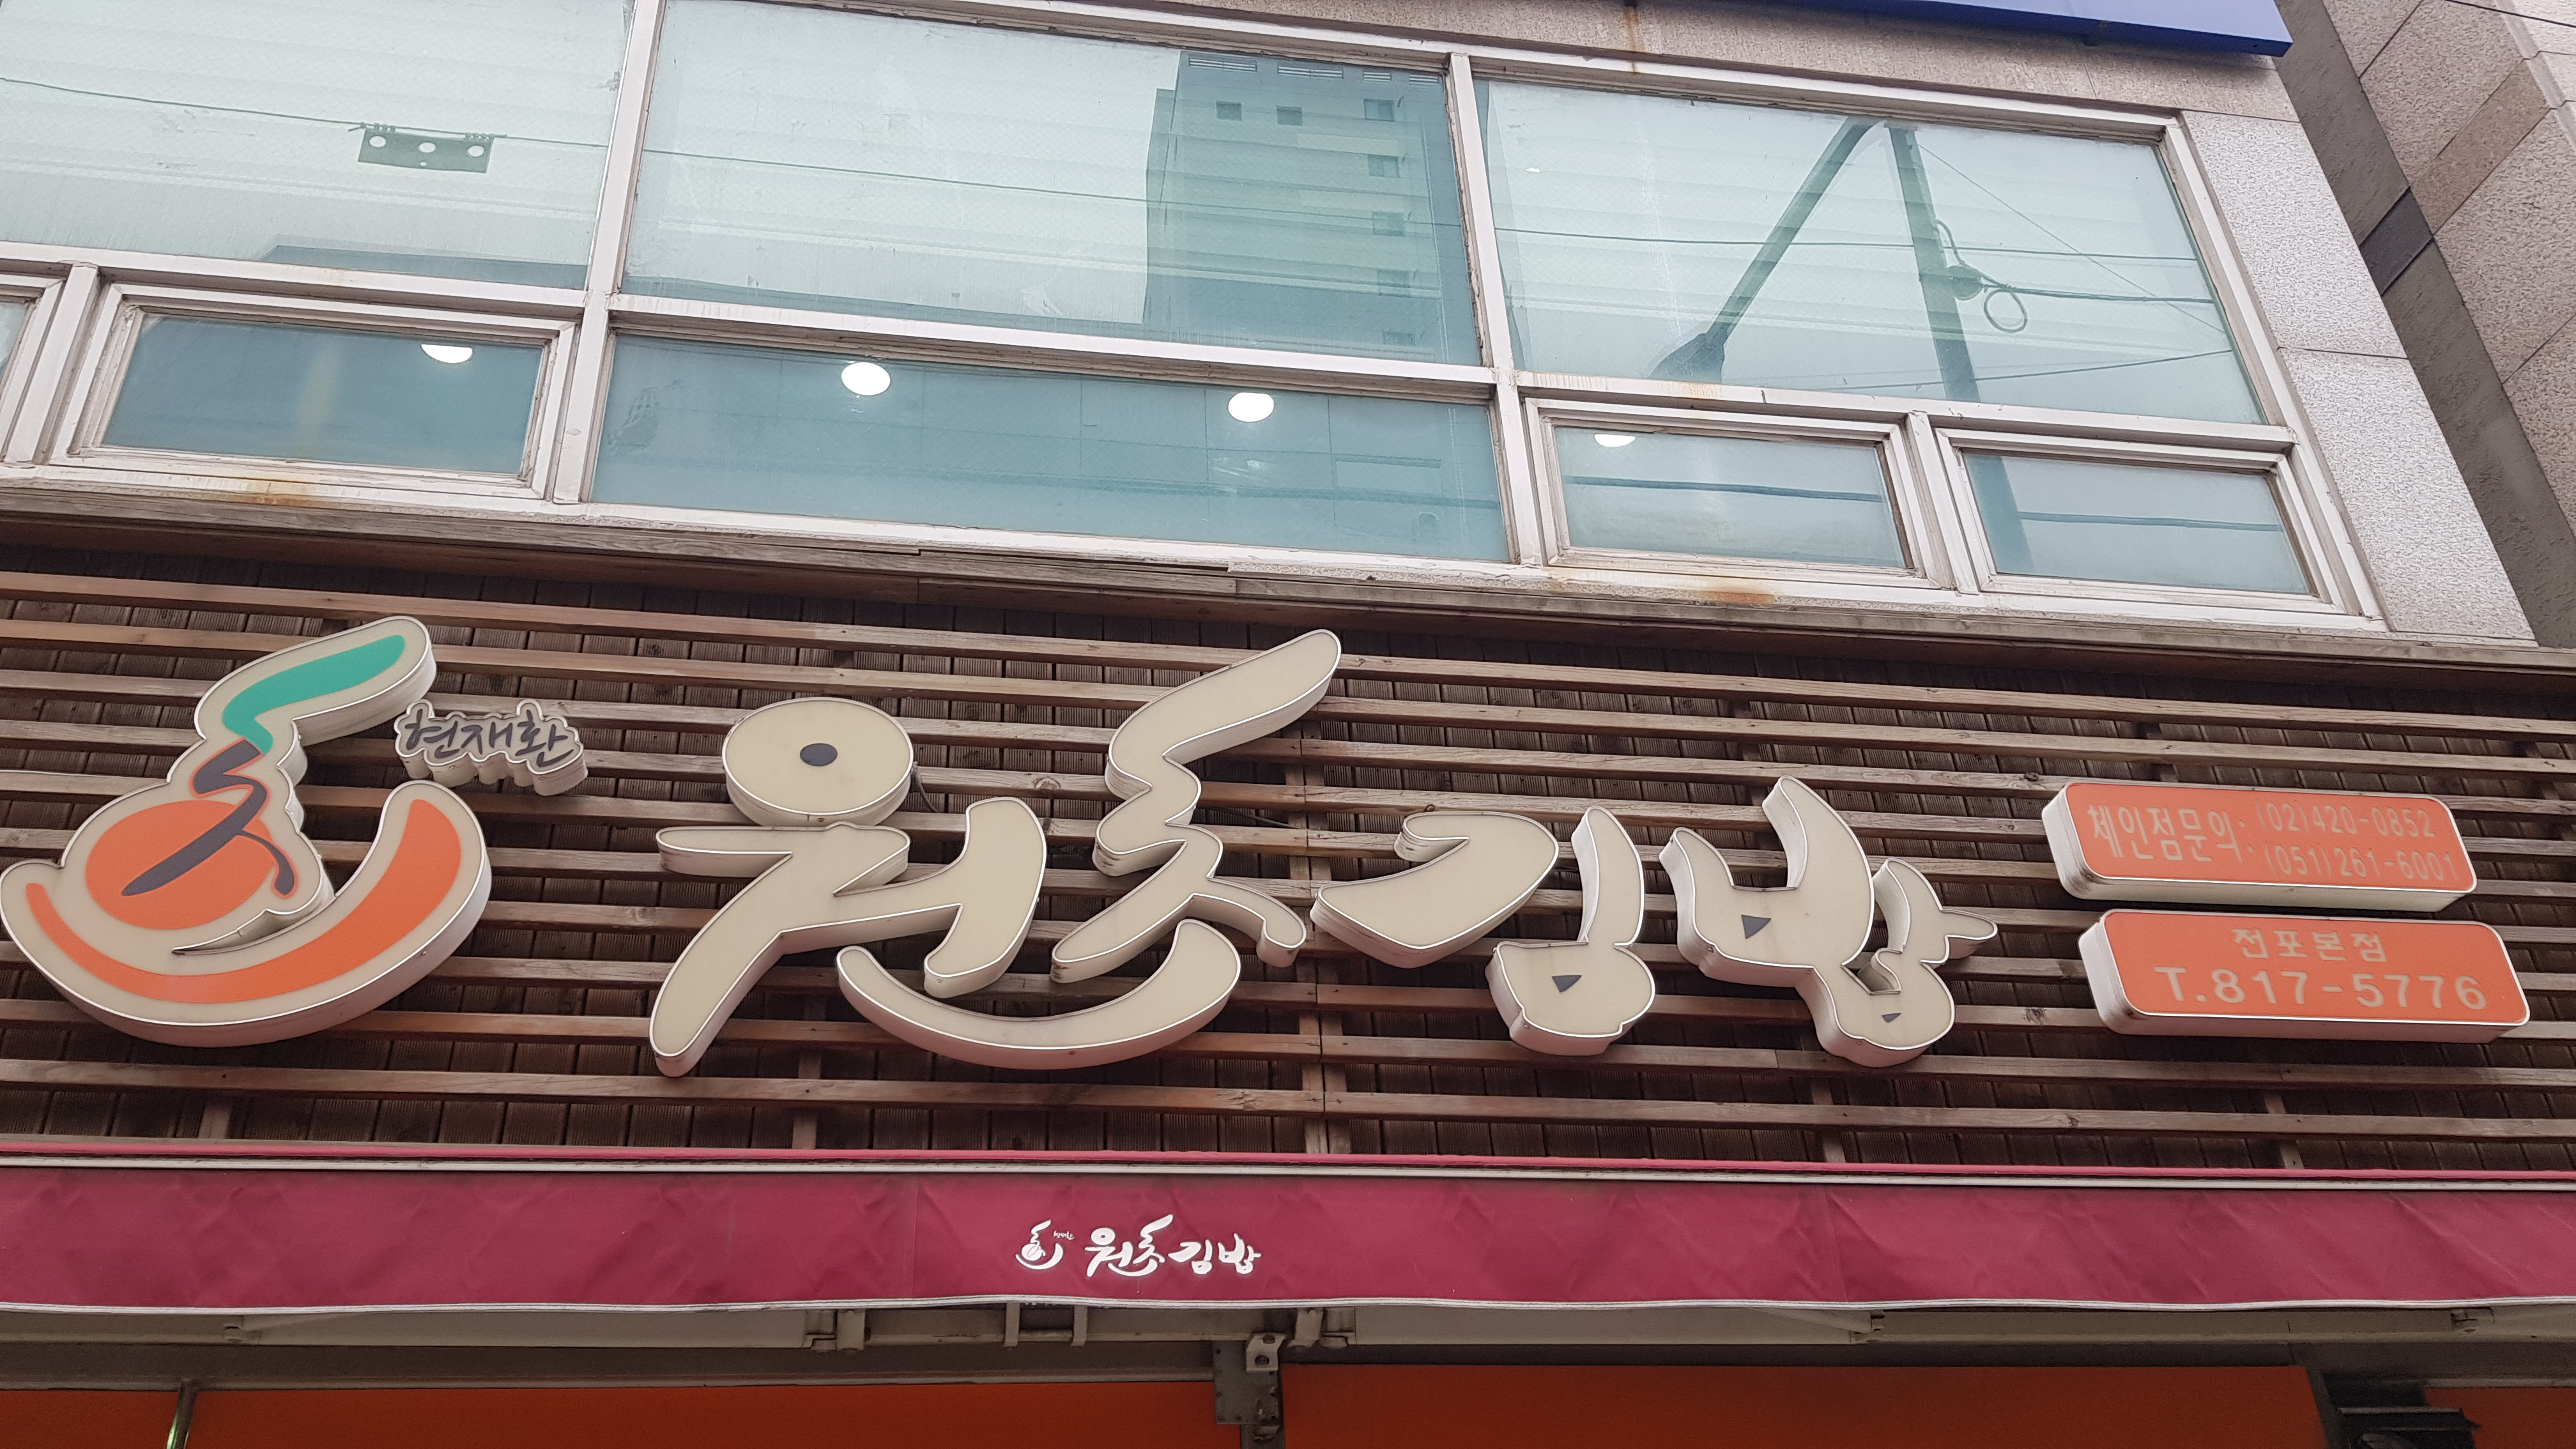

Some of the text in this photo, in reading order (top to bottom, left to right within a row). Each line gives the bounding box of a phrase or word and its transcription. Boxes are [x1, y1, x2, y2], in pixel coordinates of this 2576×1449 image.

[404, 709, 575, 767] 현재환
[2256, 799, 2436, 838] (02)420-0852
[2264, 841, 2458, 881] (051)261-6001
[2232, 928, 2387, 963] 전포본점
[2154, 965, 2488, 1011] T.817-5776
